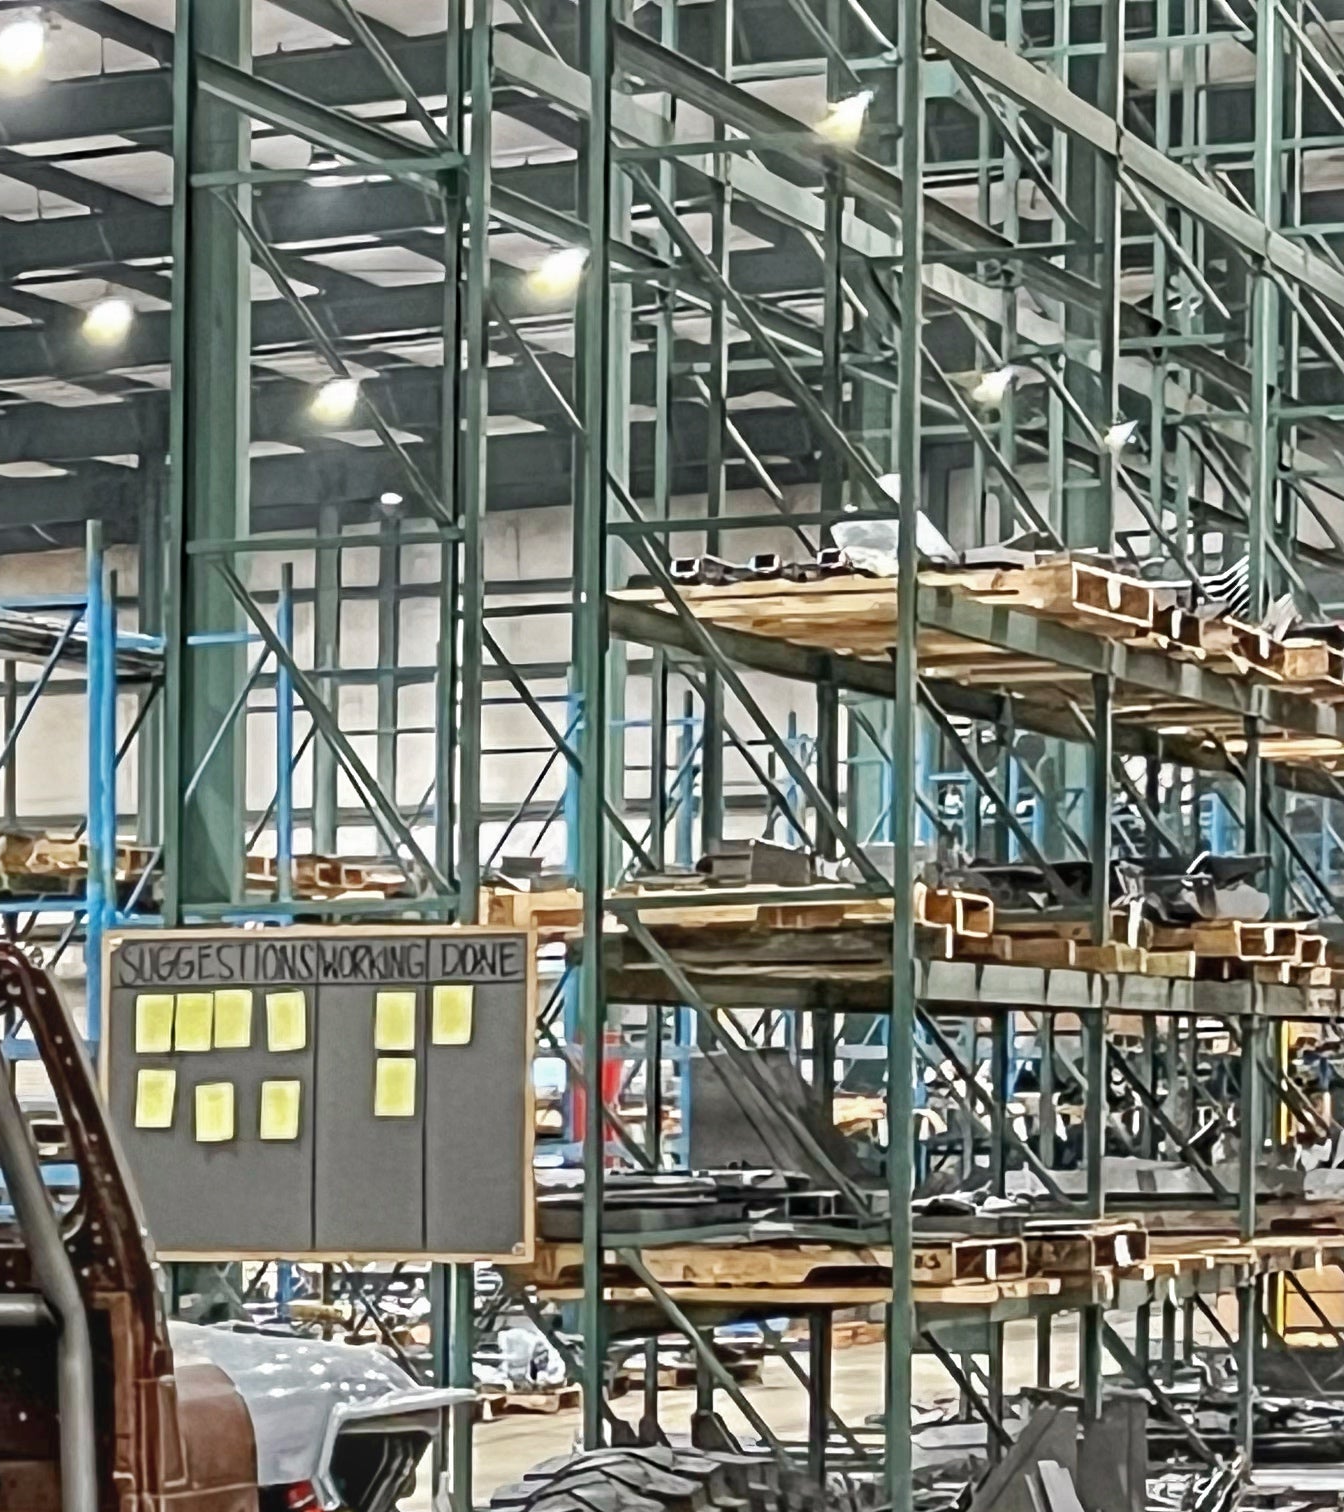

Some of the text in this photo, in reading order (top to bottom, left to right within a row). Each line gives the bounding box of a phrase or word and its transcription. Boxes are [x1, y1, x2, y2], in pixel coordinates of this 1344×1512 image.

[119, 941, 314, 986] SUGGESTIONS
[320, 942, 426, 980] WORKING
[440, 941, 520, 977] DONE
